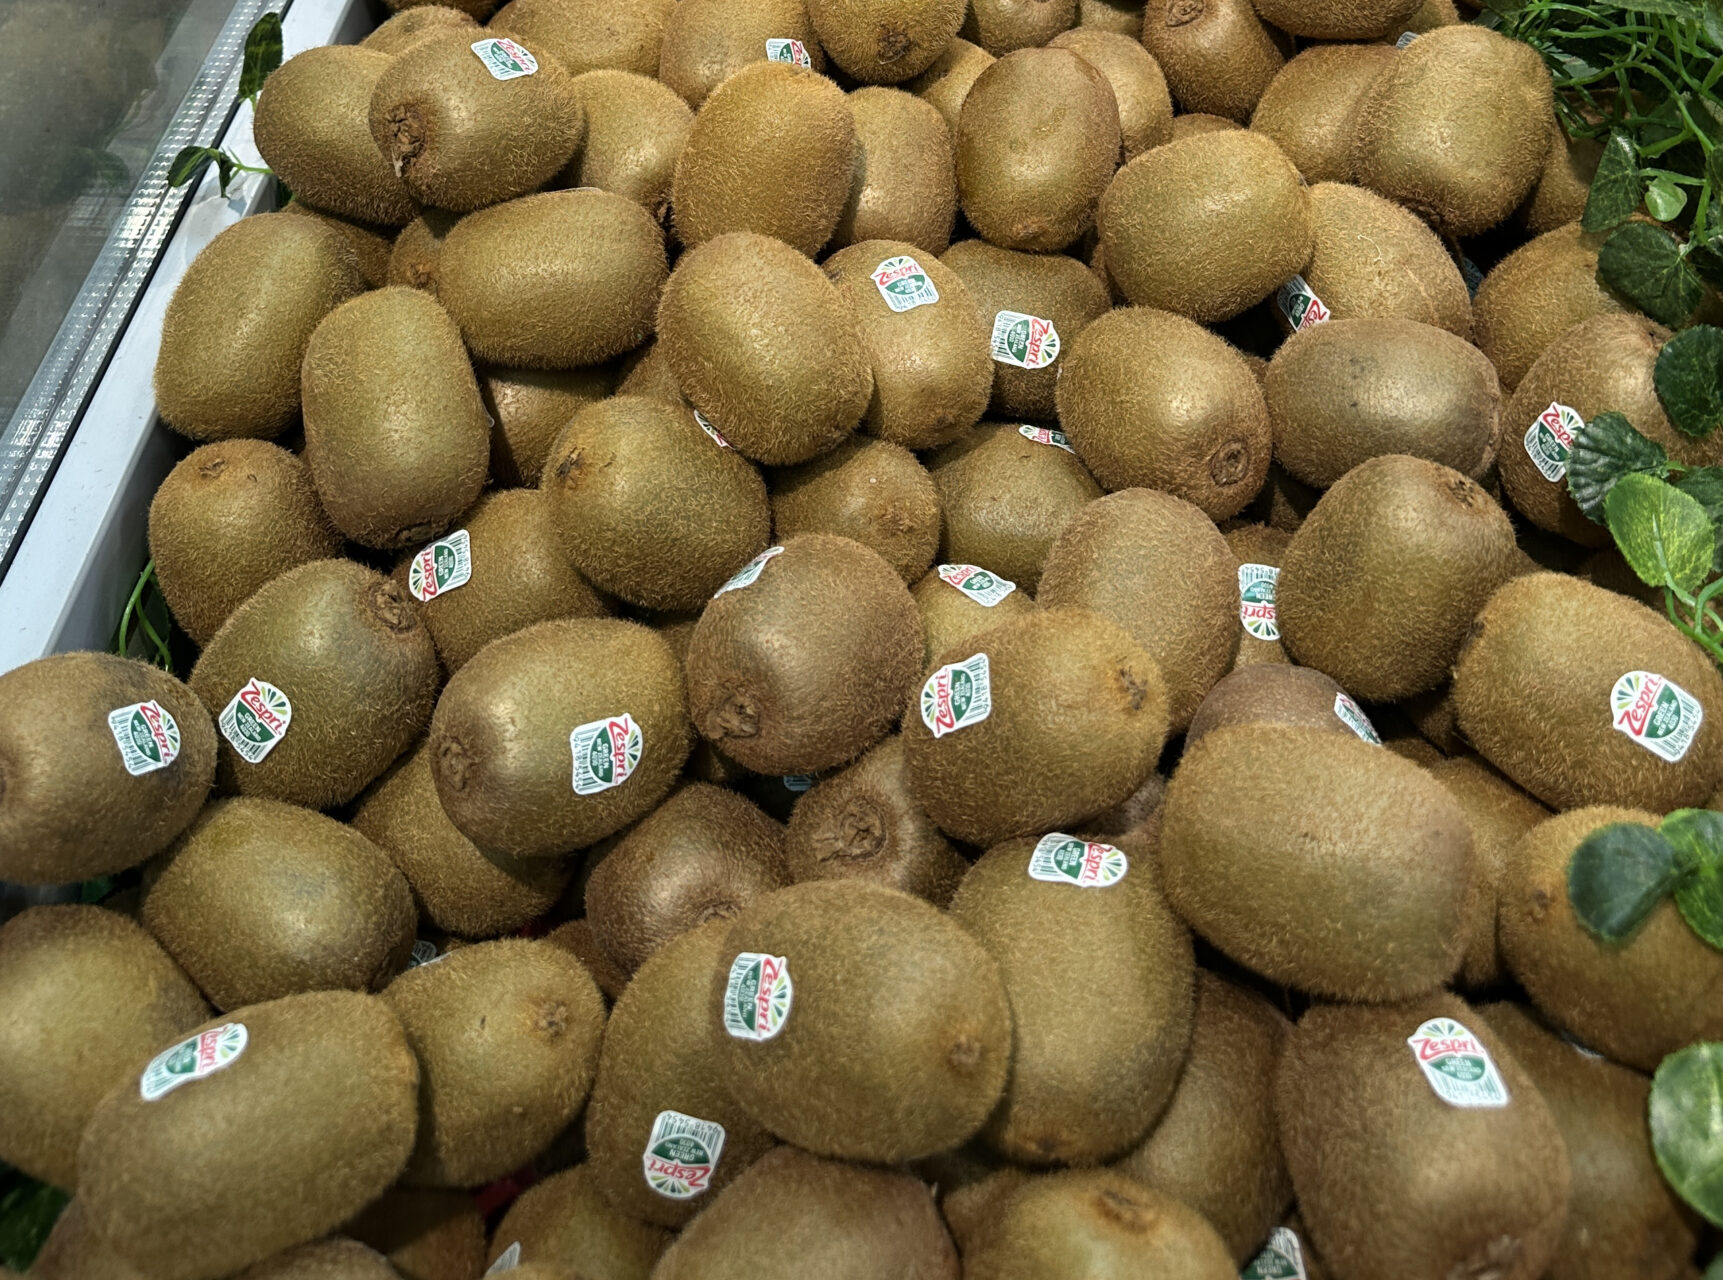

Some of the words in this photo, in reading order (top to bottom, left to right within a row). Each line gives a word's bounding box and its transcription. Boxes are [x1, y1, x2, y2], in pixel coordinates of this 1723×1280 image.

[874, 261, 920, 286] Zespri
[1026, 318, 1048, 365] Zespri
[421, 550, 436, 600] Zespri
[1241, 604, 1276, 620] spri
[238, 680, 285, 734] Zespri
[935, 673, 953, 733] Zespri
[1618, 674, 1661, 734] Zespri
[1652, 700, 1669, 726] GREEN
[1656, 722, 1665, 735] NEW
[1662, 698, 1678, 723] ZEALAND
[139, 701, 174, 763] Zespri
[140, 723, 154, 748] GREEN
[243, 712, 262, 732] GREEN
[244, 721, 261, 741] ZEALAND
[609, 719, 628, 781] Zespri
[1081, 843, 1112, 881] Zespri
[747, 979, 756, 1010] GREEN
[757, 958, 782, 1030] Zespri
[1414, 1037, 1480, 1059] Zespri
[647, 1156, 711, 1185] Zespri
[668, 1148, 694, 1160] GREEN
